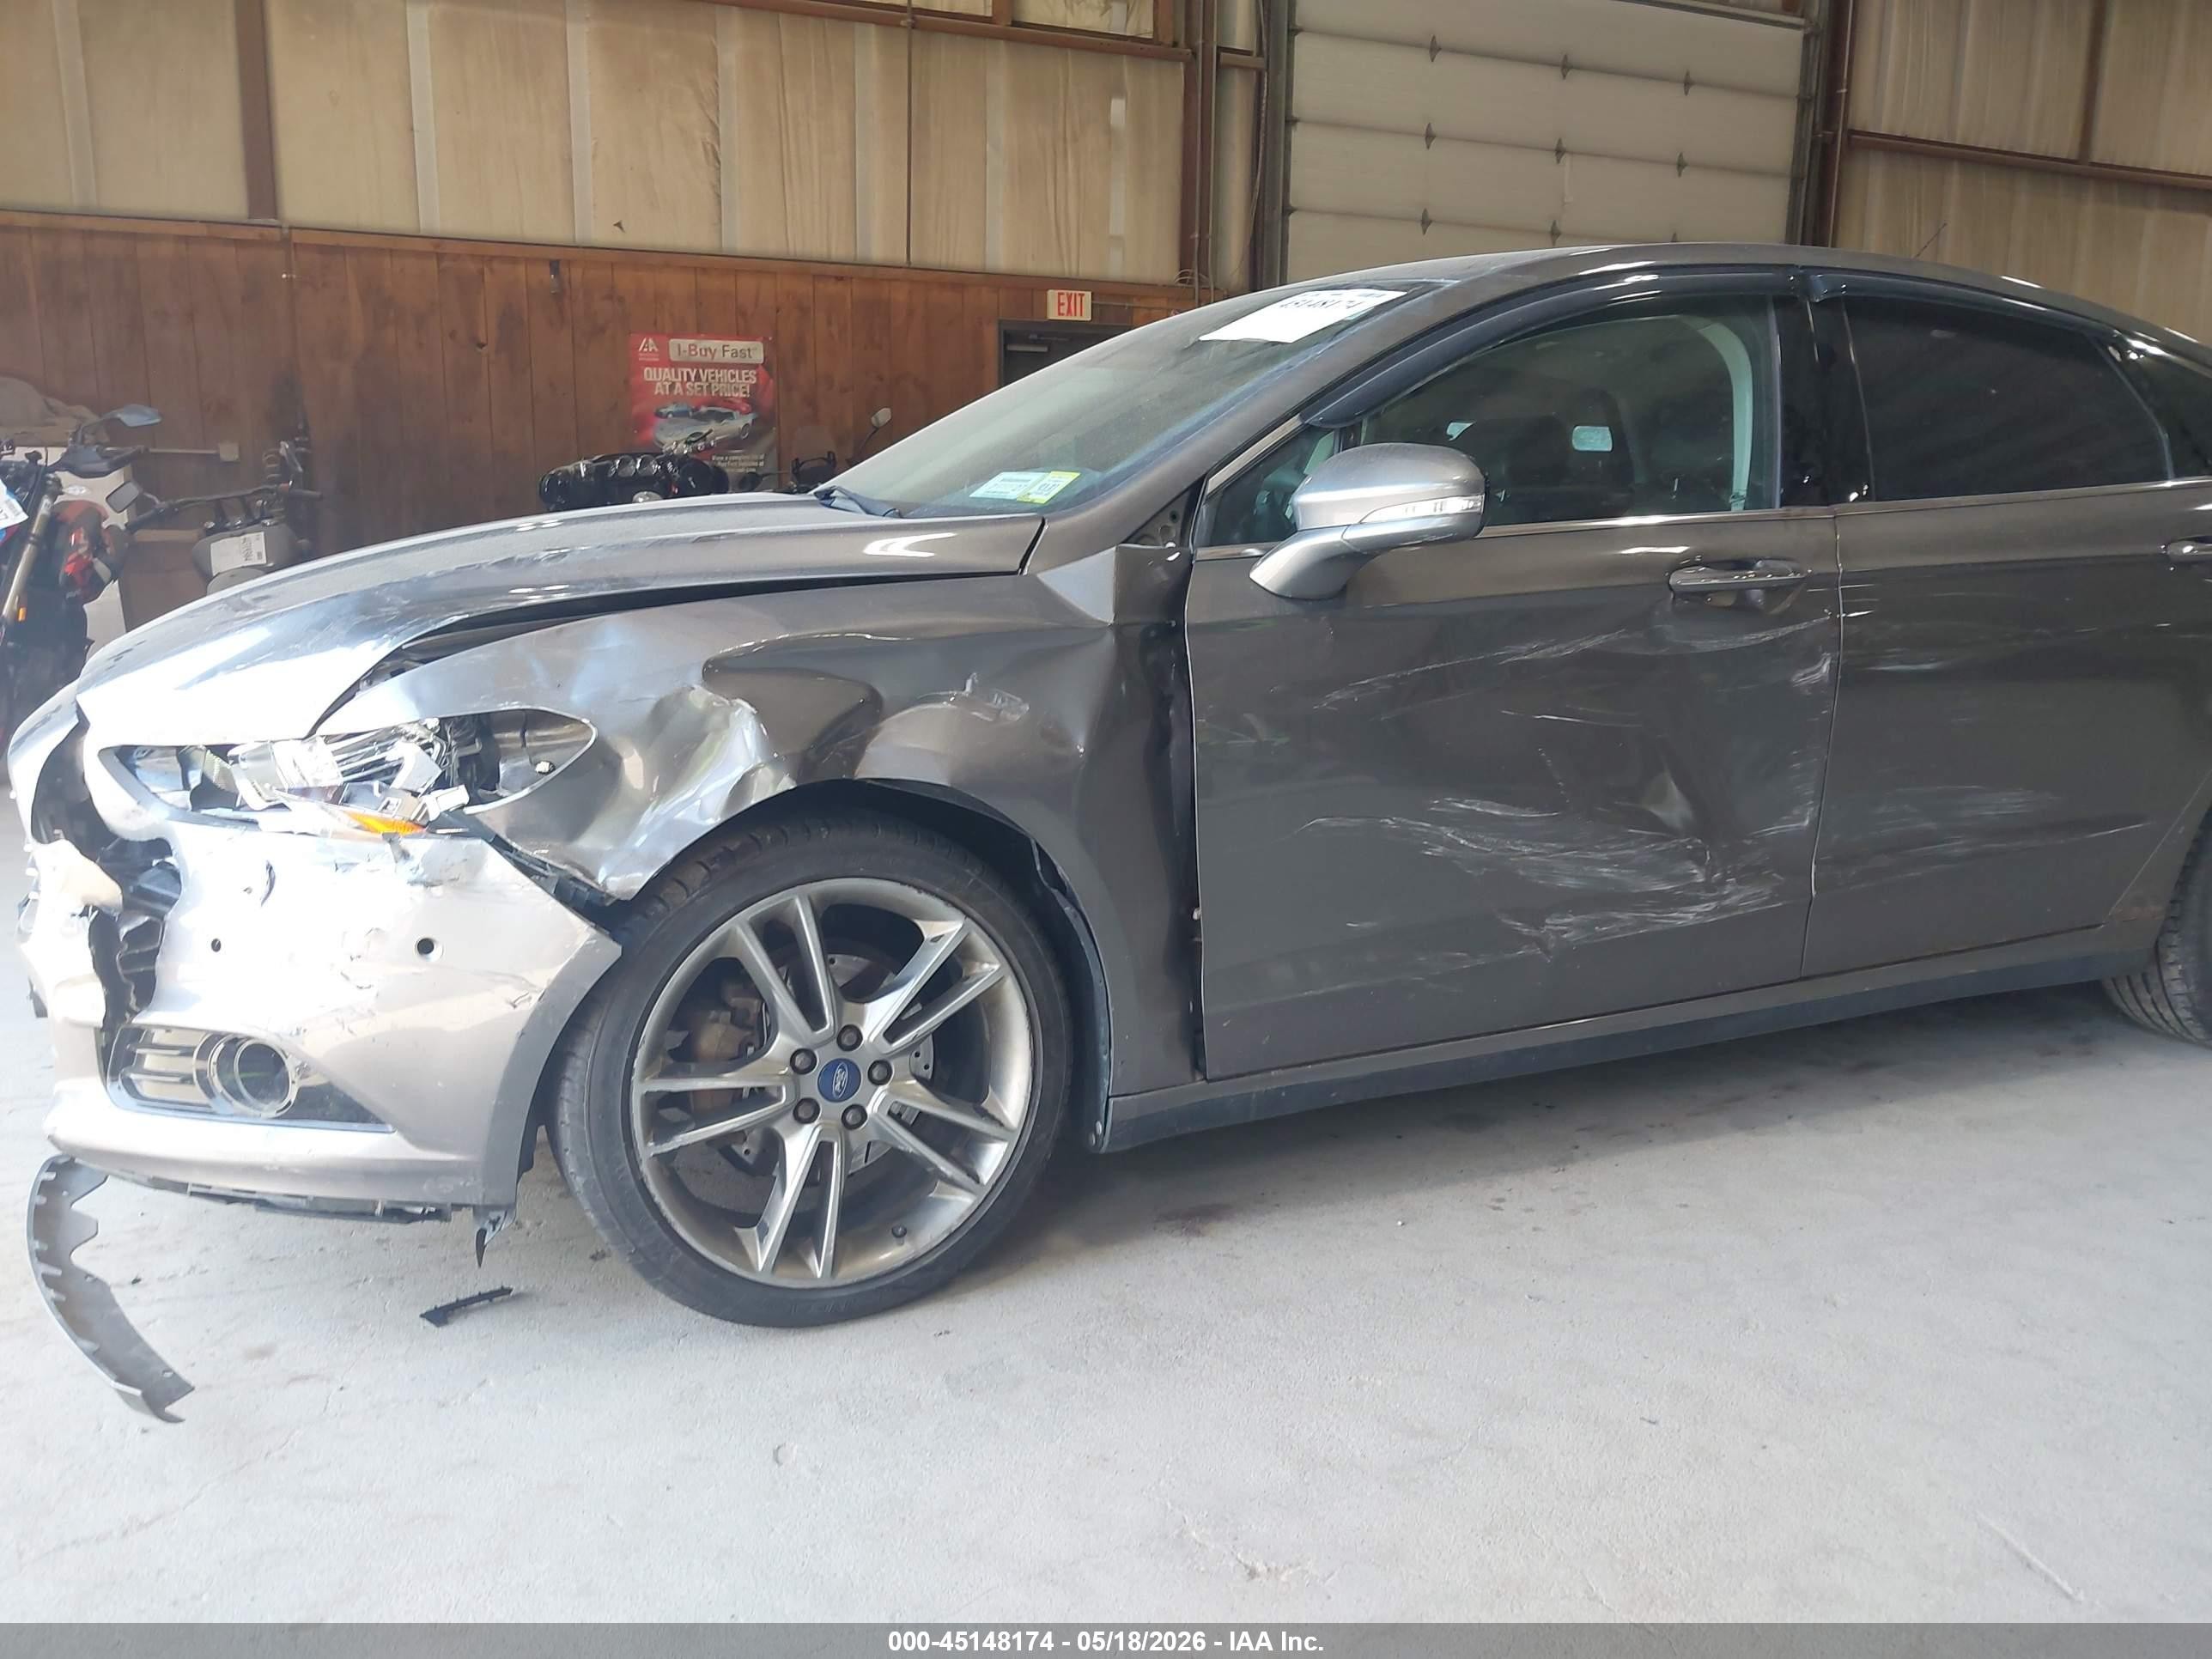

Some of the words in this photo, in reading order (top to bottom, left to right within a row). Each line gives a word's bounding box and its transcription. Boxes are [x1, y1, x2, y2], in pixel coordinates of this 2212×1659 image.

[1057, 292, 1085, 317] EXIT
[676, 343, 717, 361] I-Buy
[643, 367, 697, 382] QUALITY
[699, 368, 757, 384] VEHICLES
[654, 381, 673, 396] AT
[673, 382, 684, 396] A
[686, 381, 710, 397] SET
[711, 383, 750, 398] PRICE!
